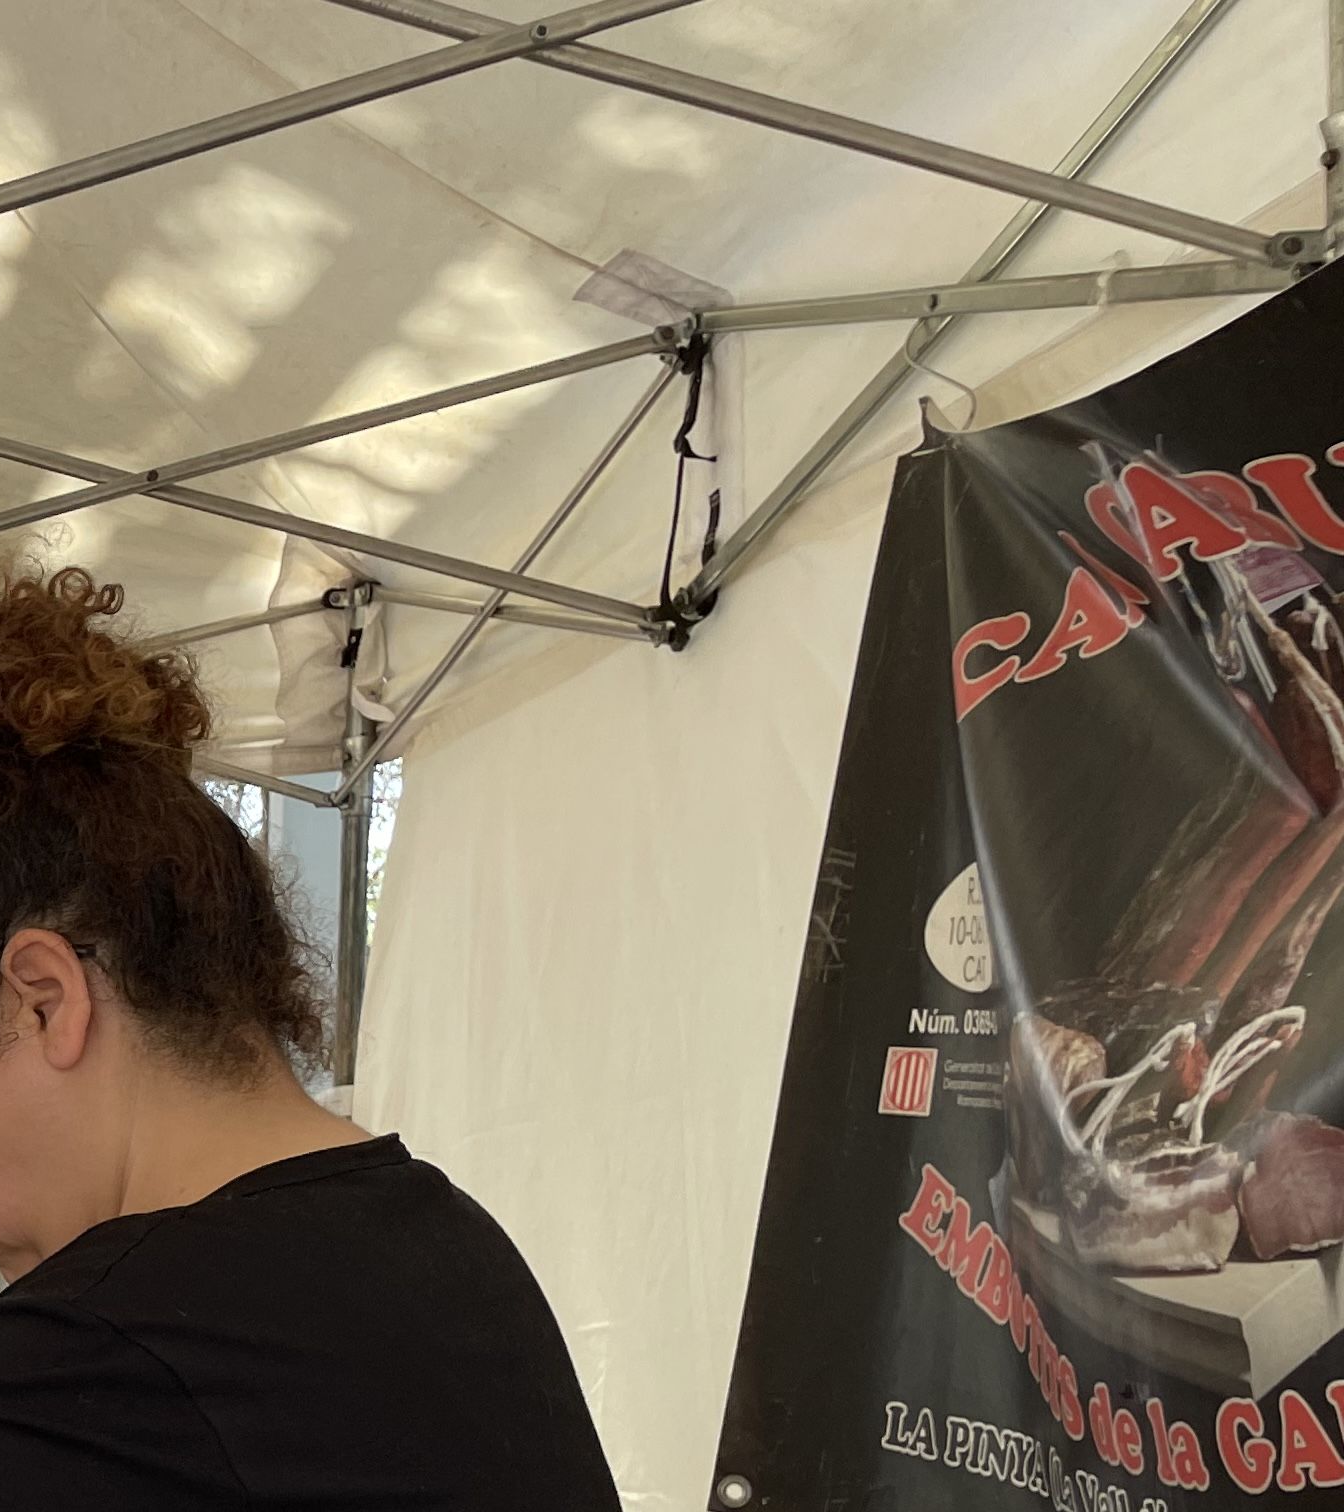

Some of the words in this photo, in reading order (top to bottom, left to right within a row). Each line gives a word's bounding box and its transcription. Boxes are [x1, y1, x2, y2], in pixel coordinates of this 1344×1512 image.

[908, 1007, 959, 1035] Núm.
[881, 1401, 939, 1461] LA
[943, 1415, 1050, 1498] PINYA
[1089, 1381, 1144, 1476] de
[1146, 1400, 1210, 1492] la
[1215, 1380, 1344, 1495] GA
